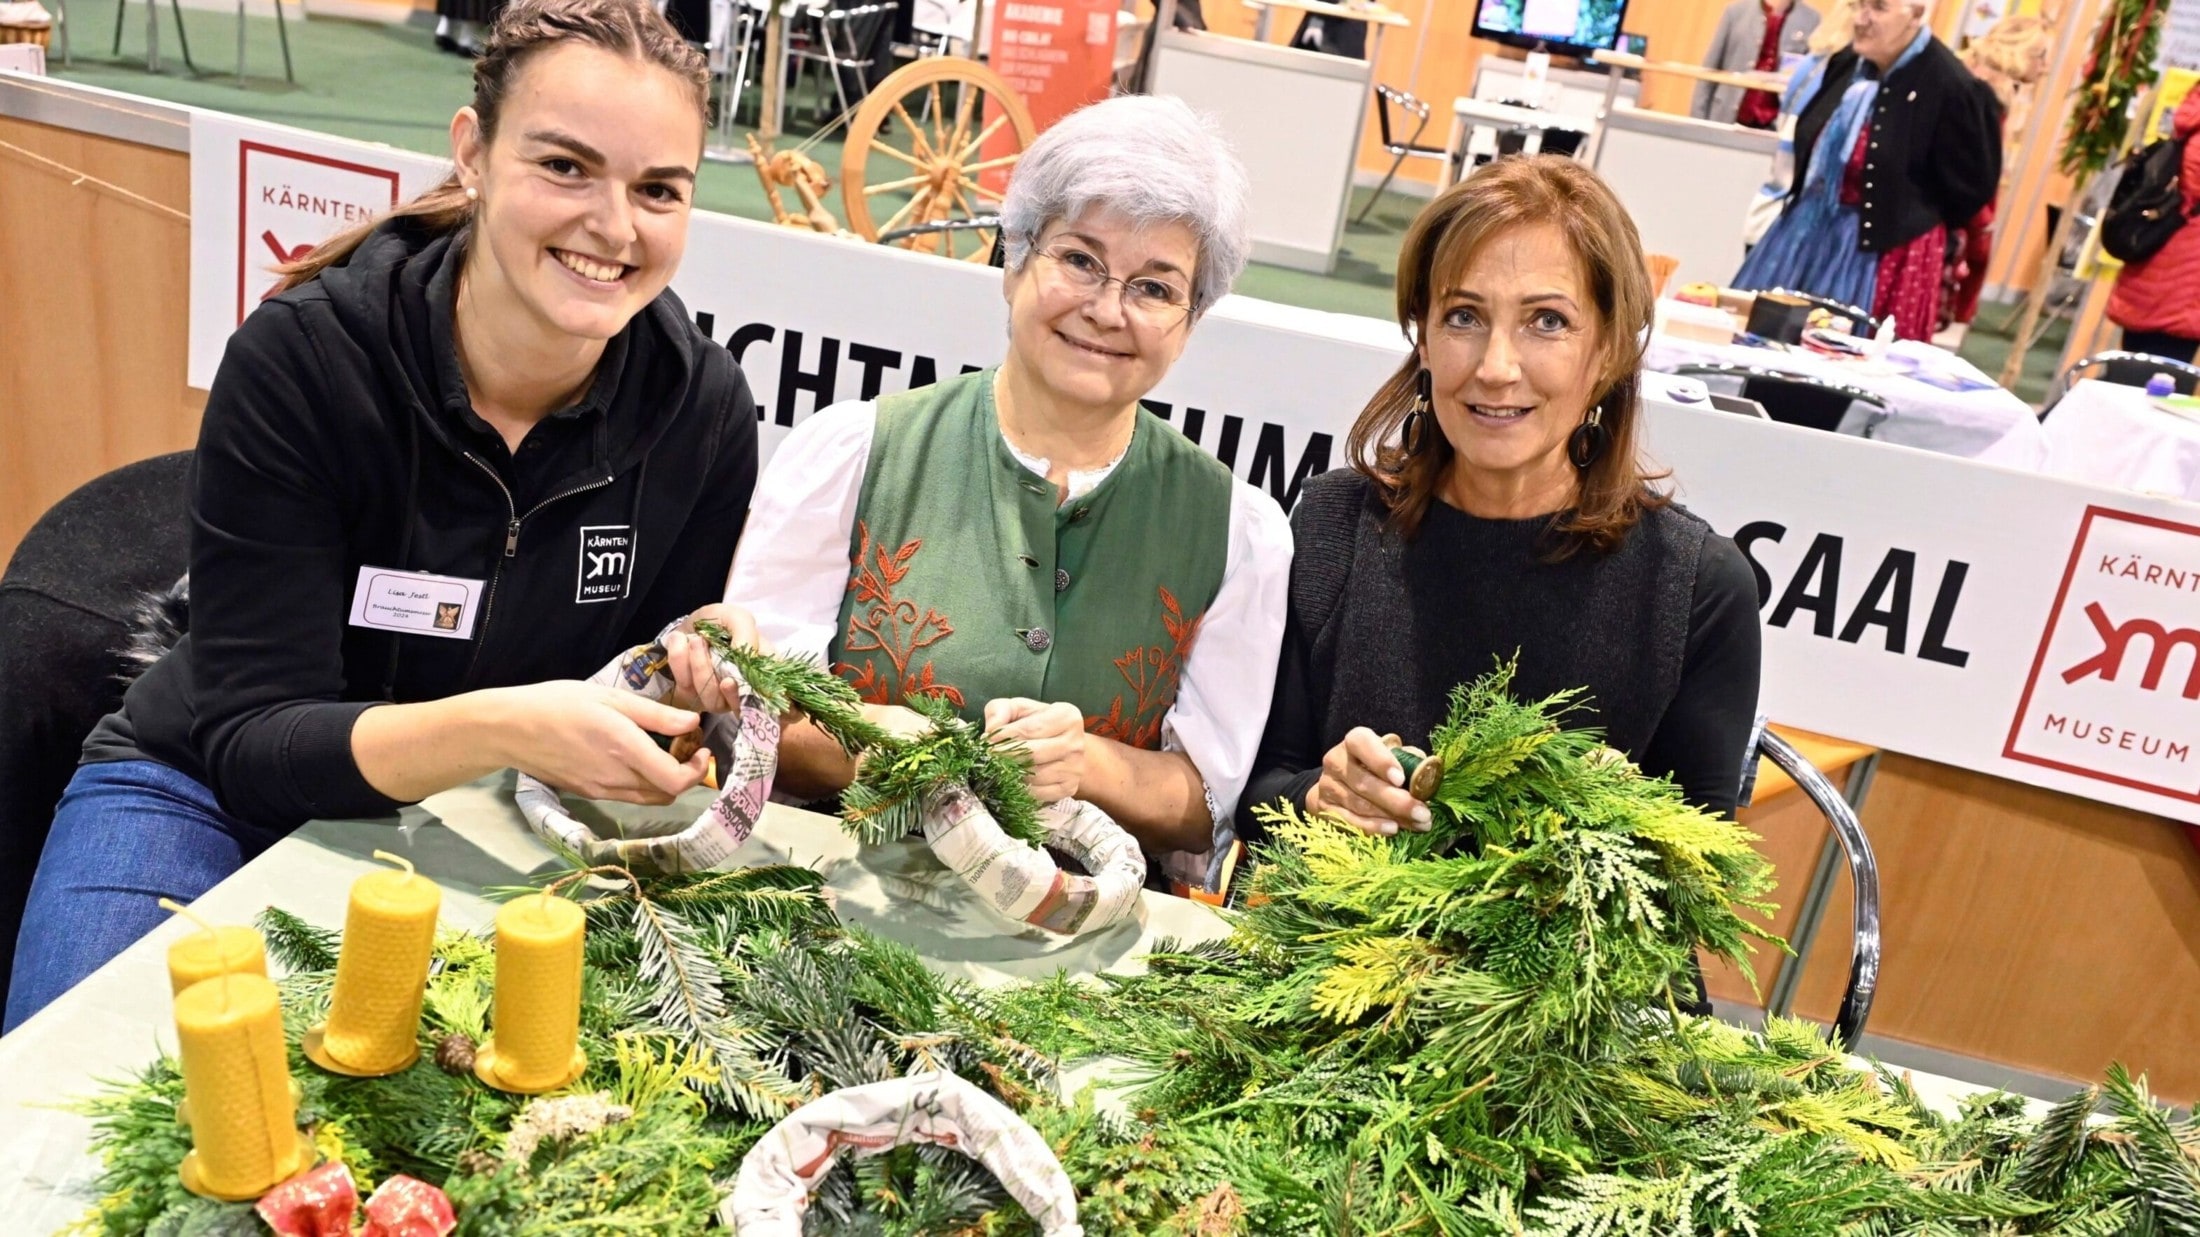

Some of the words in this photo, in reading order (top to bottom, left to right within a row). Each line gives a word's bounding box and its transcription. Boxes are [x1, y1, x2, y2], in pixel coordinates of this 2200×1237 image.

[262, 184, 374, 224] KÄRNTEN
[587, 535, 629, 548] KÄRNTEN
[1733, 520, 1970, 669] SAAL
[2043, 713, 2190, 763] MUSEUM
